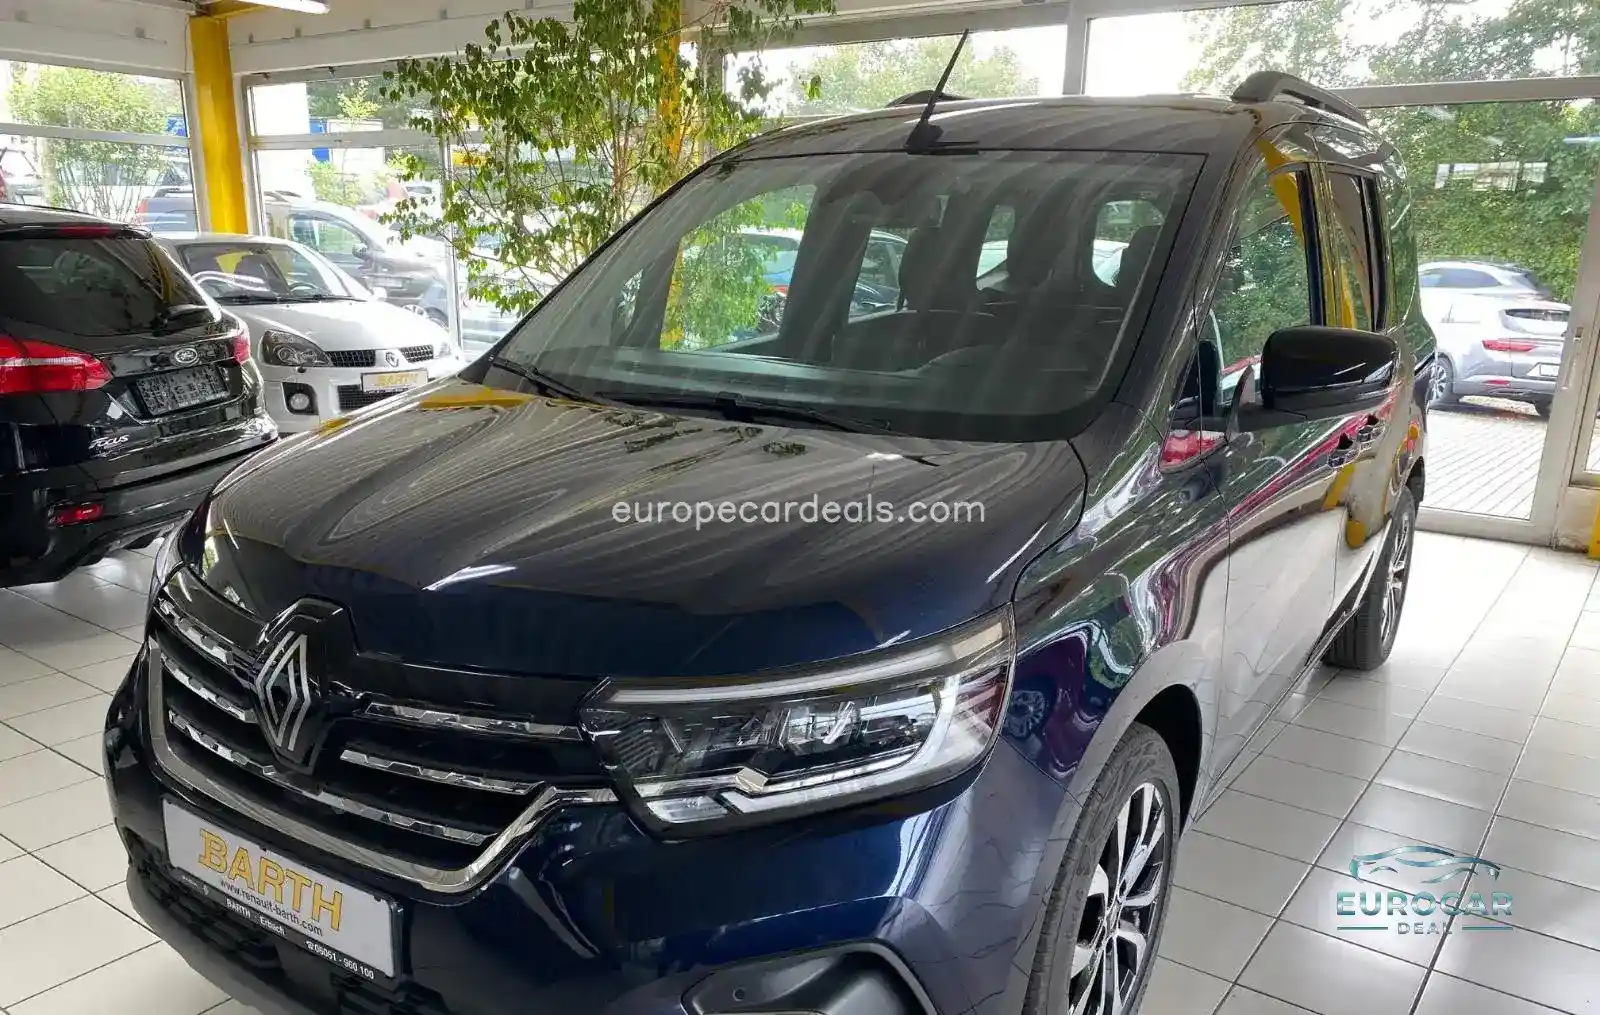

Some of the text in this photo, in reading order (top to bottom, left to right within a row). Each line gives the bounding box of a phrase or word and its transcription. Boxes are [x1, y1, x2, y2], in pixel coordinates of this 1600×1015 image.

[197, 828, 343, 932] BARTH
[219, 878, 324, 937] www.renault-barth.com
[225, 898, 251, 919] BARTH
[359, 966, 375, 979] 100
